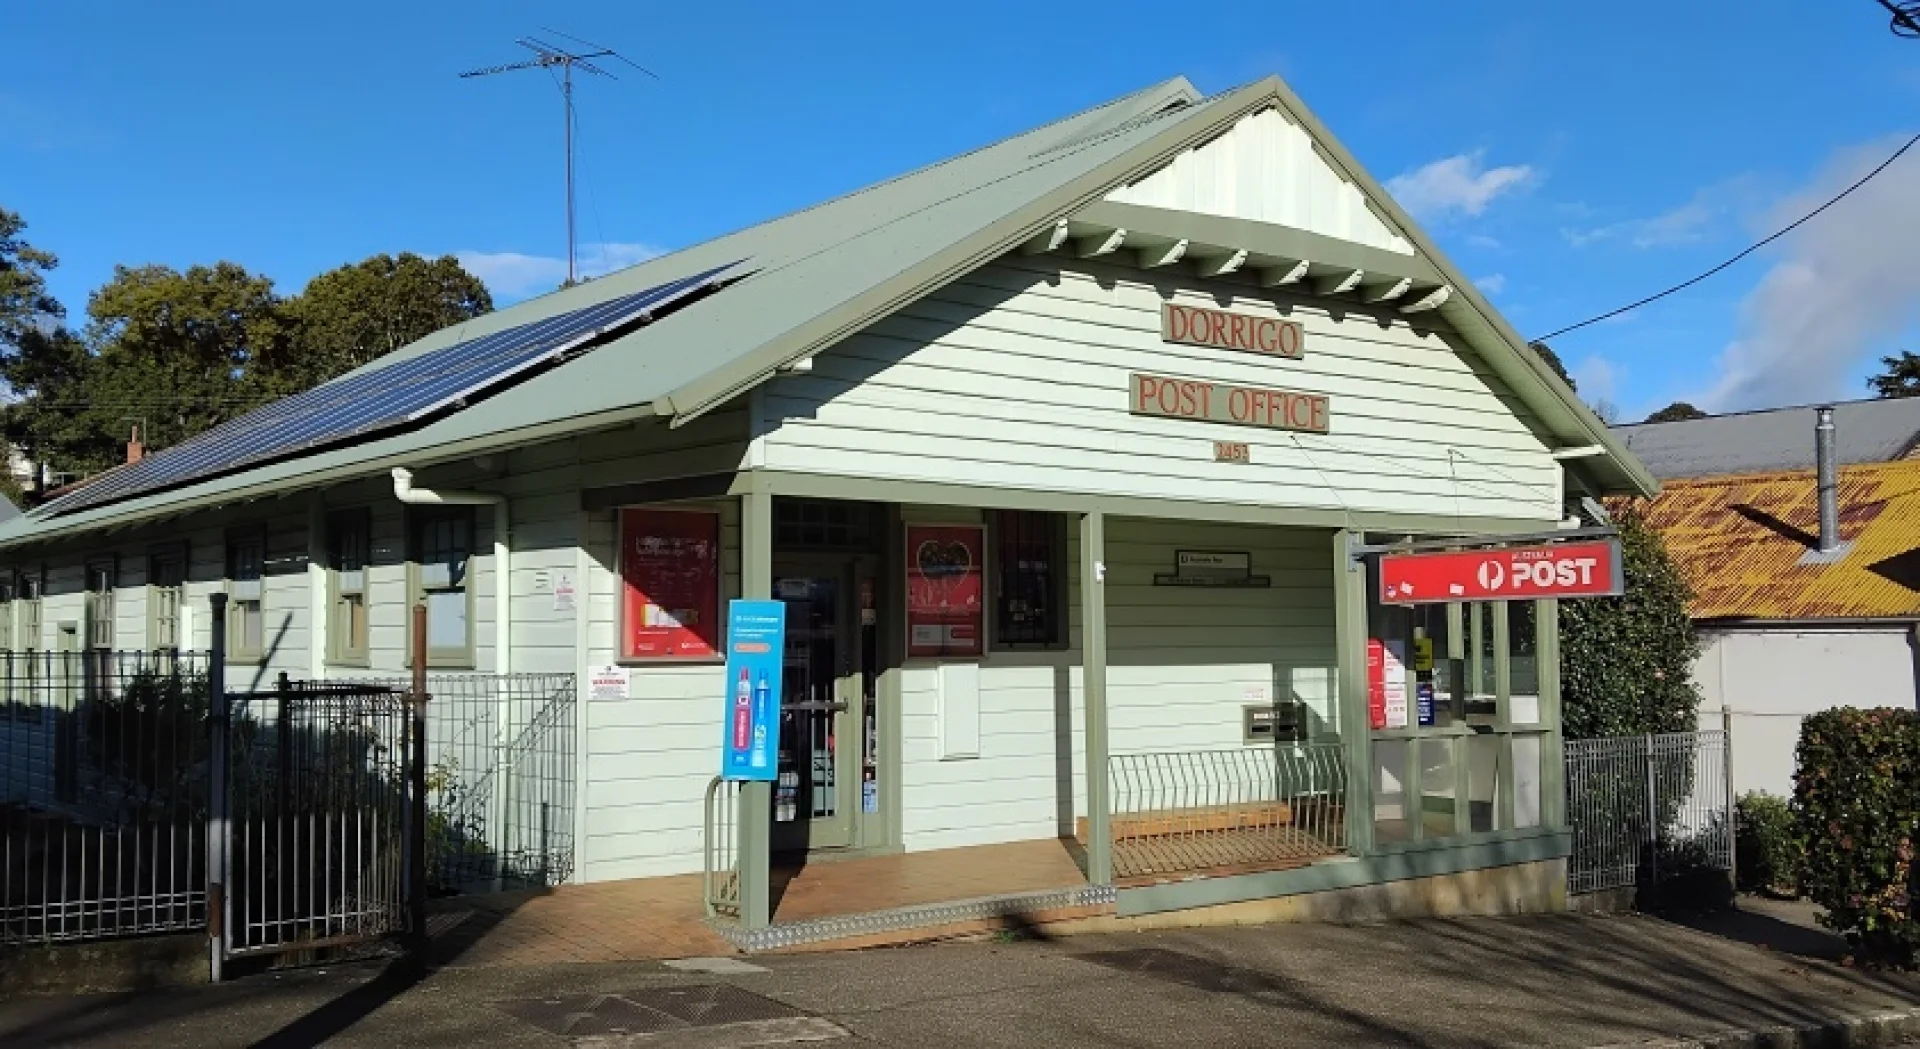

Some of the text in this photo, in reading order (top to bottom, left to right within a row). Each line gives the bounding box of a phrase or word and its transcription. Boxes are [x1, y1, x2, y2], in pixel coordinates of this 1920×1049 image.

[1169, 306, 1297, 355] DORRIGO
[1138, 377, 1325, 429] POST OFFICE
[1511, 558, 1597, 588] POST
